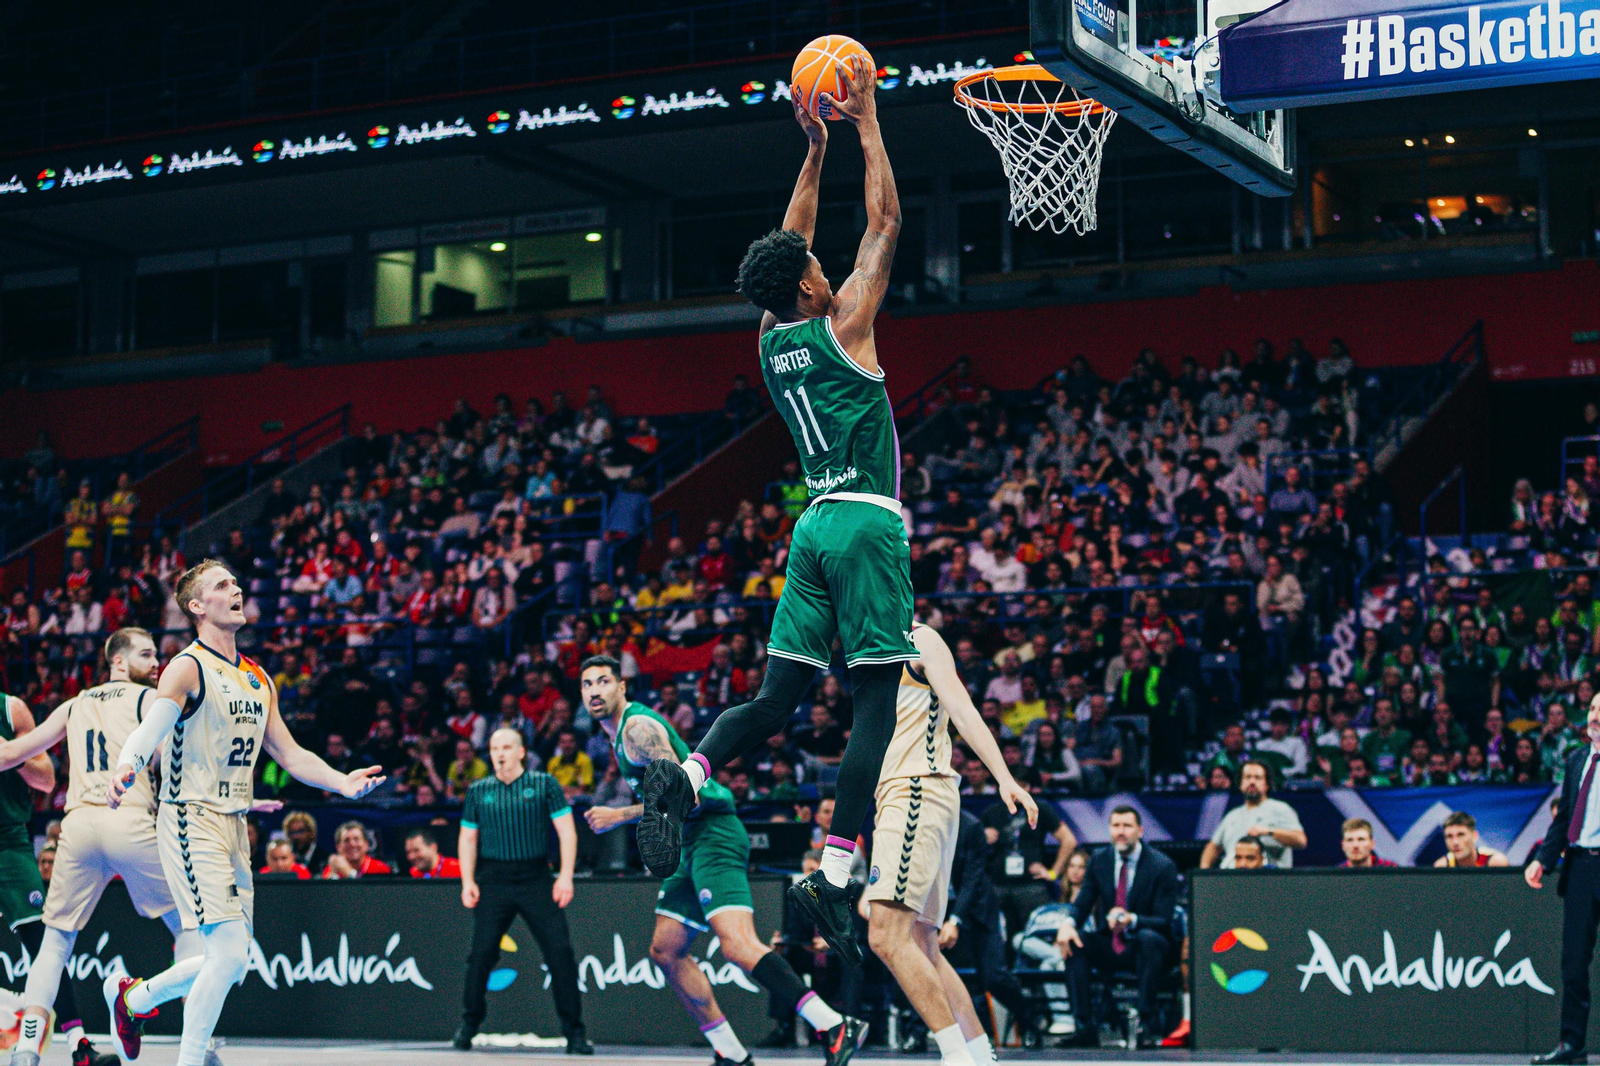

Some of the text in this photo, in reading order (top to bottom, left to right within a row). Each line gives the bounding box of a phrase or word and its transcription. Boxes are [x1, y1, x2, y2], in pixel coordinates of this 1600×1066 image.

[1092, 0, 1115, 26] FOUR
[769, 347, 813, 374] CARTER
[784, 385, 829, 456] 11
[229, 700, 263, 717] UCAM
[86, 728, 109, 773] 11
[228, 737, 255, 767] 22
[238, 931, 434, 991] Andalucía
[1297, 928, 1556, 996] Andalucía
